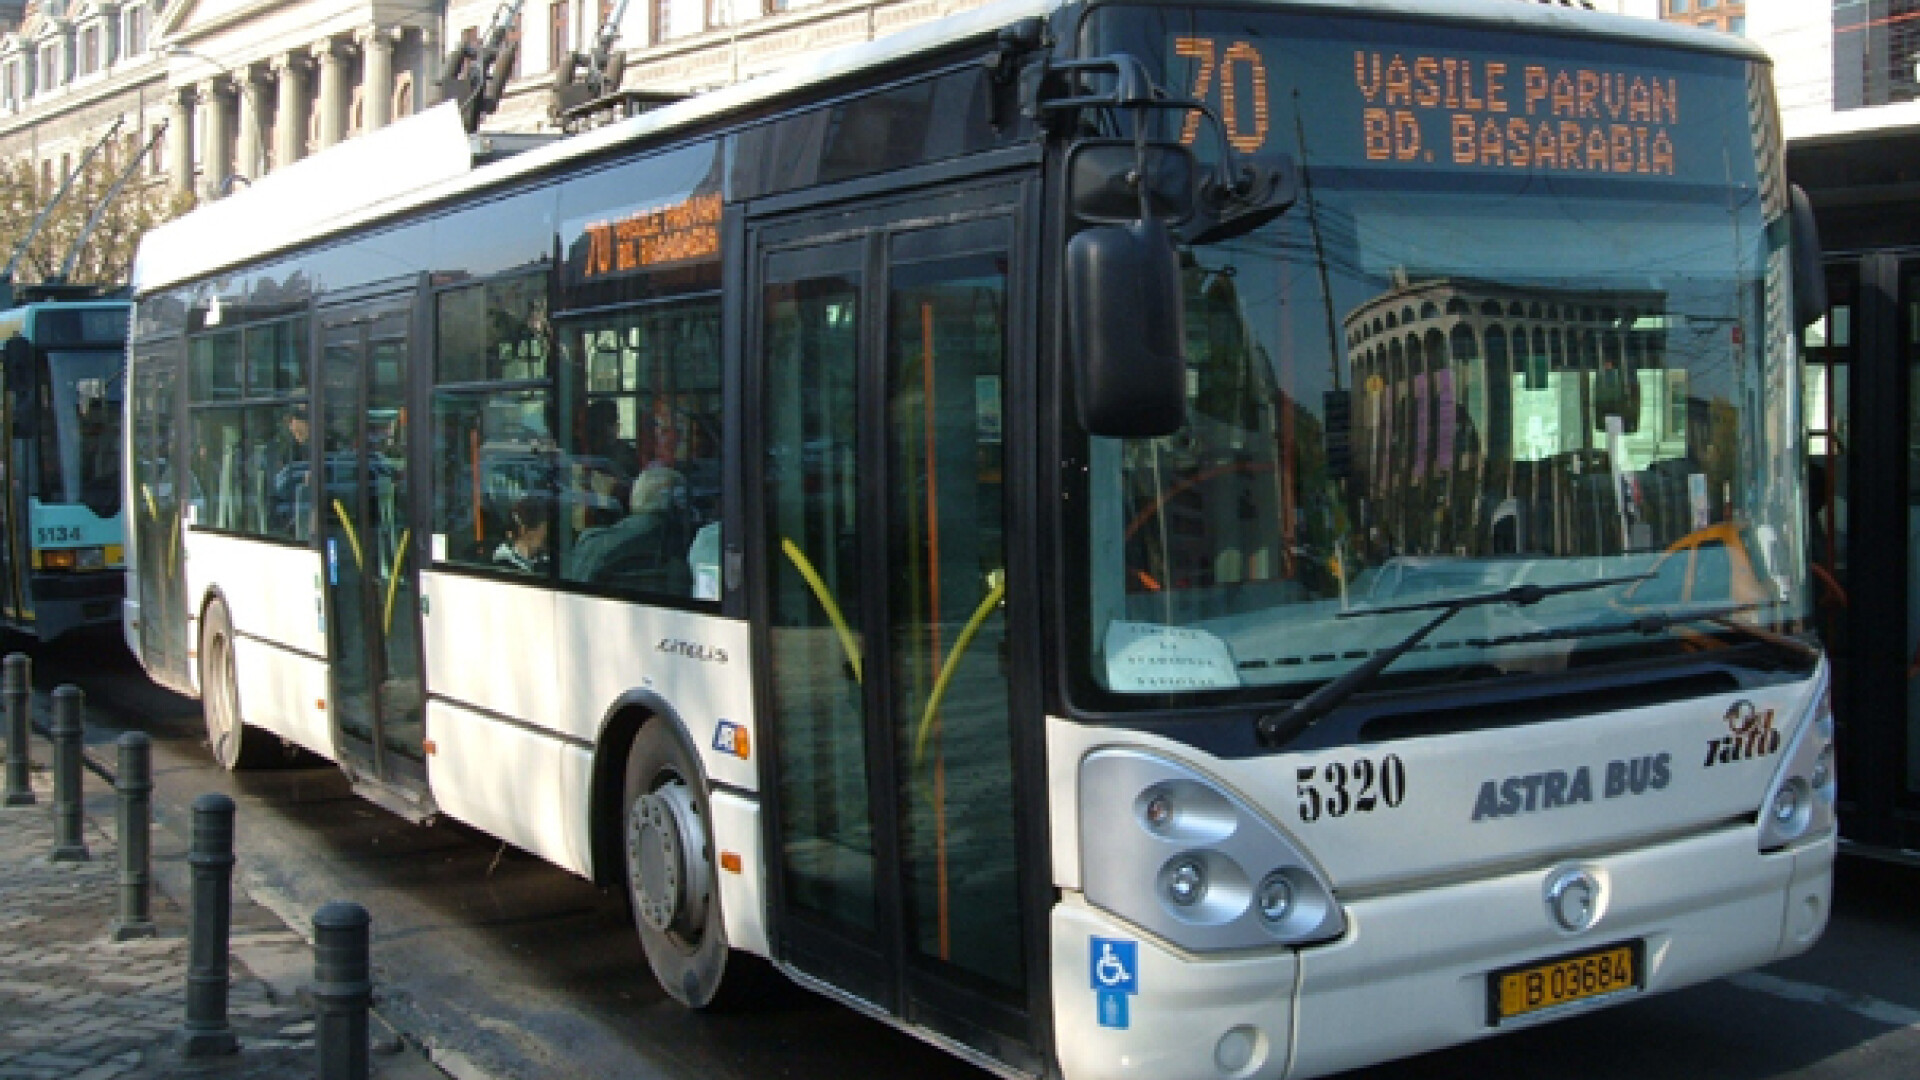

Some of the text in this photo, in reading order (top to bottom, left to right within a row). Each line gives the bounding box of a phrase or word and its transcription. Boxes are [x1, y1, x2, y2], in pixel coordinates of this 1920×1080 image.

[1175, 37, 1268, 153] 70
[1354, 50, 1677, 124] VASILE PARVAN
[1363, 107, 1675, 175] BD. BASARABIA
[1296, 753, 1405, 823] 5320
[1471, 752, 1672, 823] ASTRA BUS
[1526, 953, 1626, 1006] B 03684
